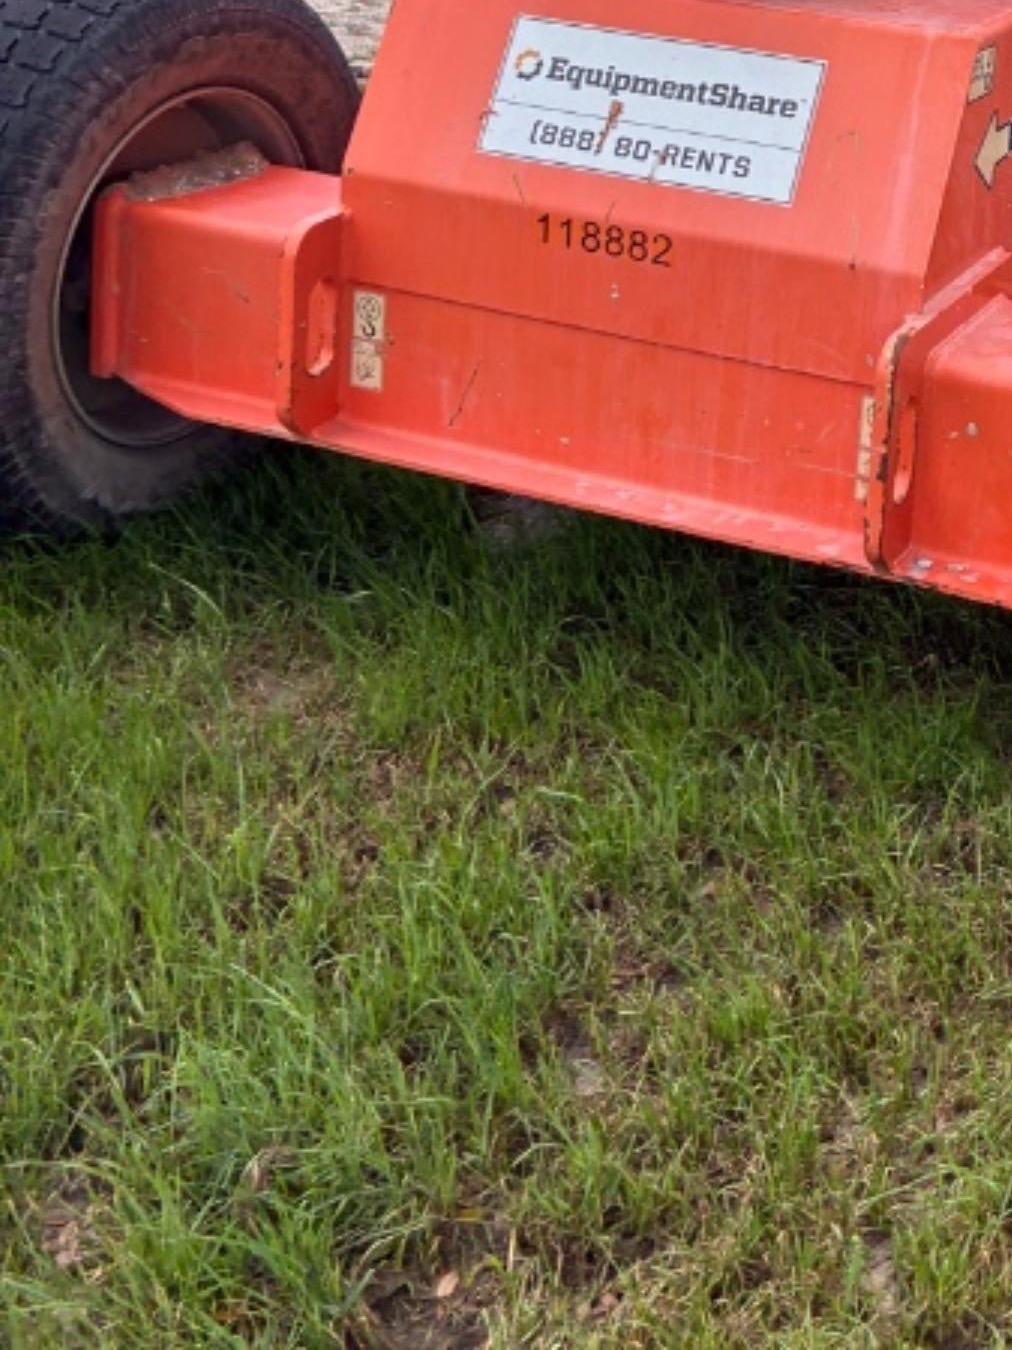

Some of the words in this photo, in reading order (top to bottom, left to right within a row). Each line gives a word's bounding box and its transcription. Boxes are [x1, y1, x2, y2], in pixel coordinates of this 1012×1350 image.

[545, 56, 799, 119] EquipmentShare
[613, 135, 752, 179] 80-RENTS
[537, 212, 674, 268] 118882
